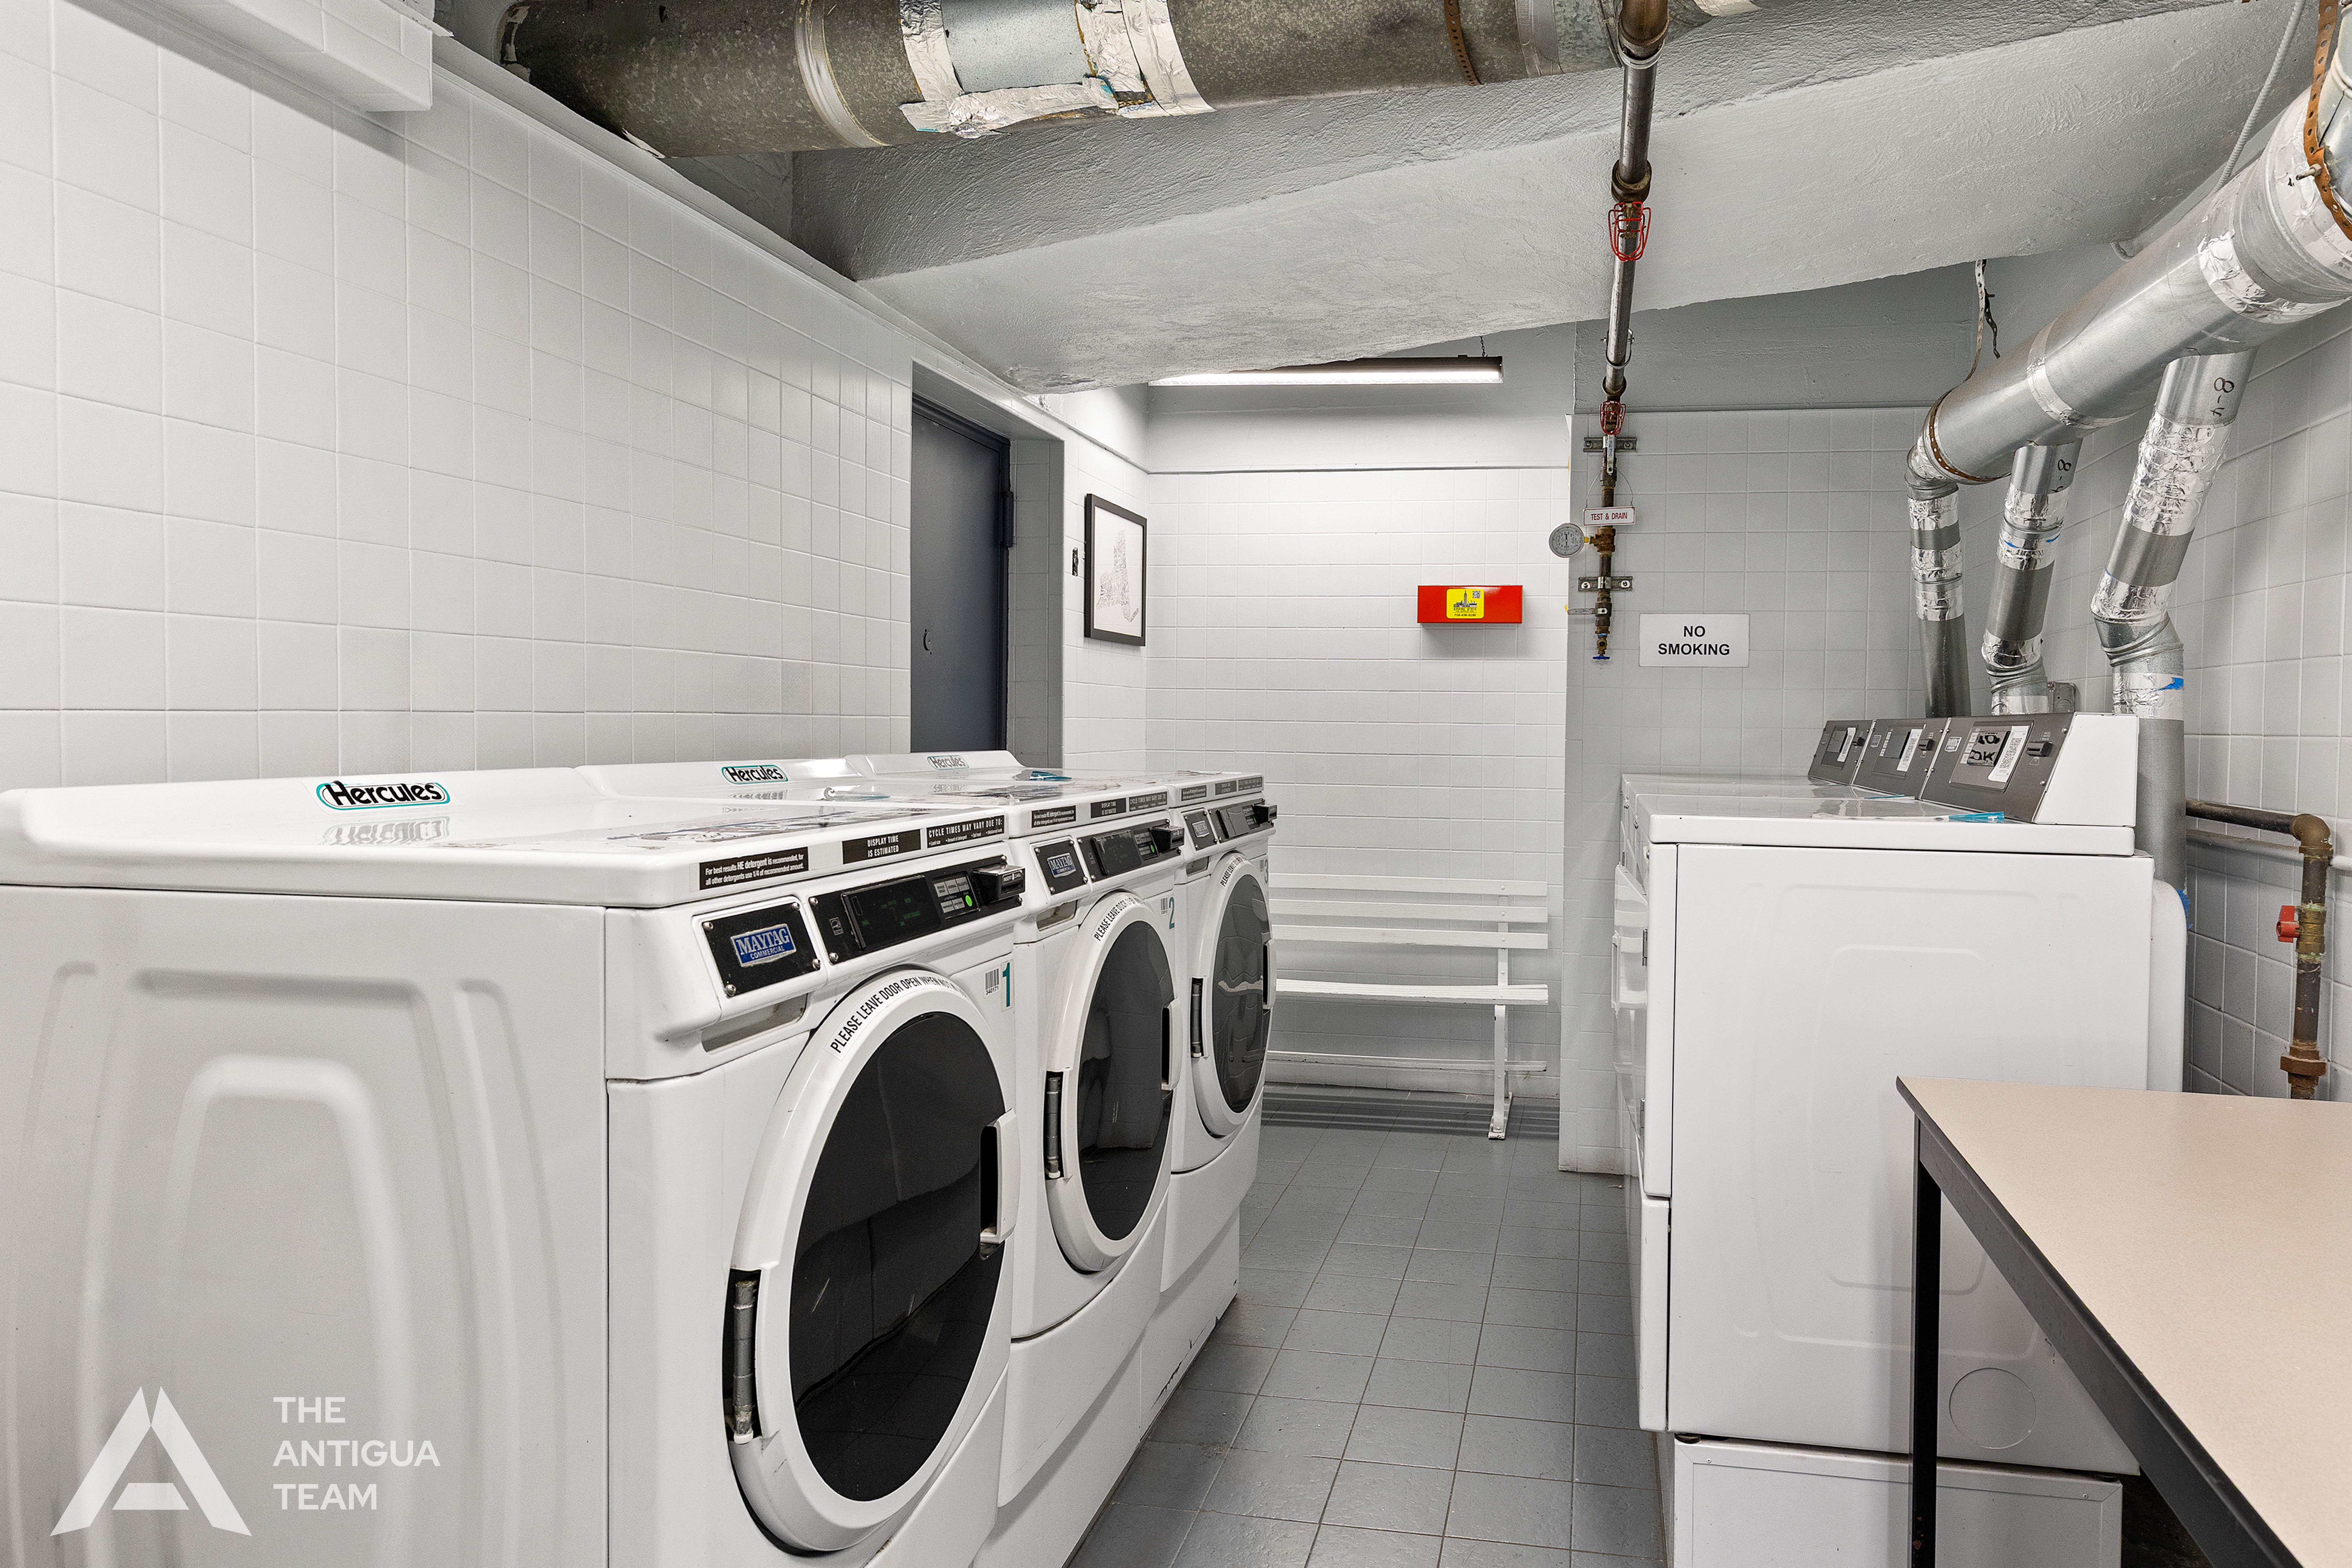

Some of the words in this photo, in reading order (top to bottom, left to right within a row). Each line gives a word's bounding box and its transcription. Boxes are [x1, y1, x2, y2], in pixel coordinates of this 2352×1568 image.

[2210, 377, 2235, 417] 8-4
[1684, 626, 1705, 637] NO
[1658, 643, 1730, 655] SMOKING
[929, 756, 965, 768] Hercules
[725, 765, 783, 782] Hercules
[324, 780, 442, 806] Hercules
[929, 828, 944, 838] CYCLE
[946, 825, 961, 834] TIMES
[962, 823, 972, 832] MAY
[973, 821, 985, 830] VARY
[986, 819, 994, 827] DUE
[867, 836, 887, 847] DISPLAY
[887, 835, 899, 844] TIME
[868, 849, 873, 858] IS
[874, 845, 899, 857] ESTIMATED
[713, 866, 723, 874] best
[723, 864, 737, 872] results
[737, 861, 744, 870] HE
[745, 858, 767, 869] detergent
[768, 857, 772, 865] is
[1050, 856, 1072, 870] MAYTAG
[1265, 859, 1268, 884] 3
[712, 876, 723, 884] other
[723, 873, 744, 883] detergents
[764, 865, 789, 875] recommended
[790, 863, 804, 871] amount.
[1220, 870, 1231, 887] PLEASE
[1169, 897, 1175, 929] 2
[1094, 919, 1110, 941] PLEASE
[1106, 906, 1120, 922] LEAVE
[736, 928, 790, 955] MAYTAG
[750, 945, 785, 959] COMMERCIAL
[986, 986, 999, 995] 340171
[1003, 962, 1010, 1007] 1
[830, 1015, 862, 1053] PLEASE
[856, 994, 883, 1019] LEAVE
[879, 982, 904, 1000] DOOR
[900, 977, 922, 989] OPEN
[918, 976, 941, 986] WHEN
